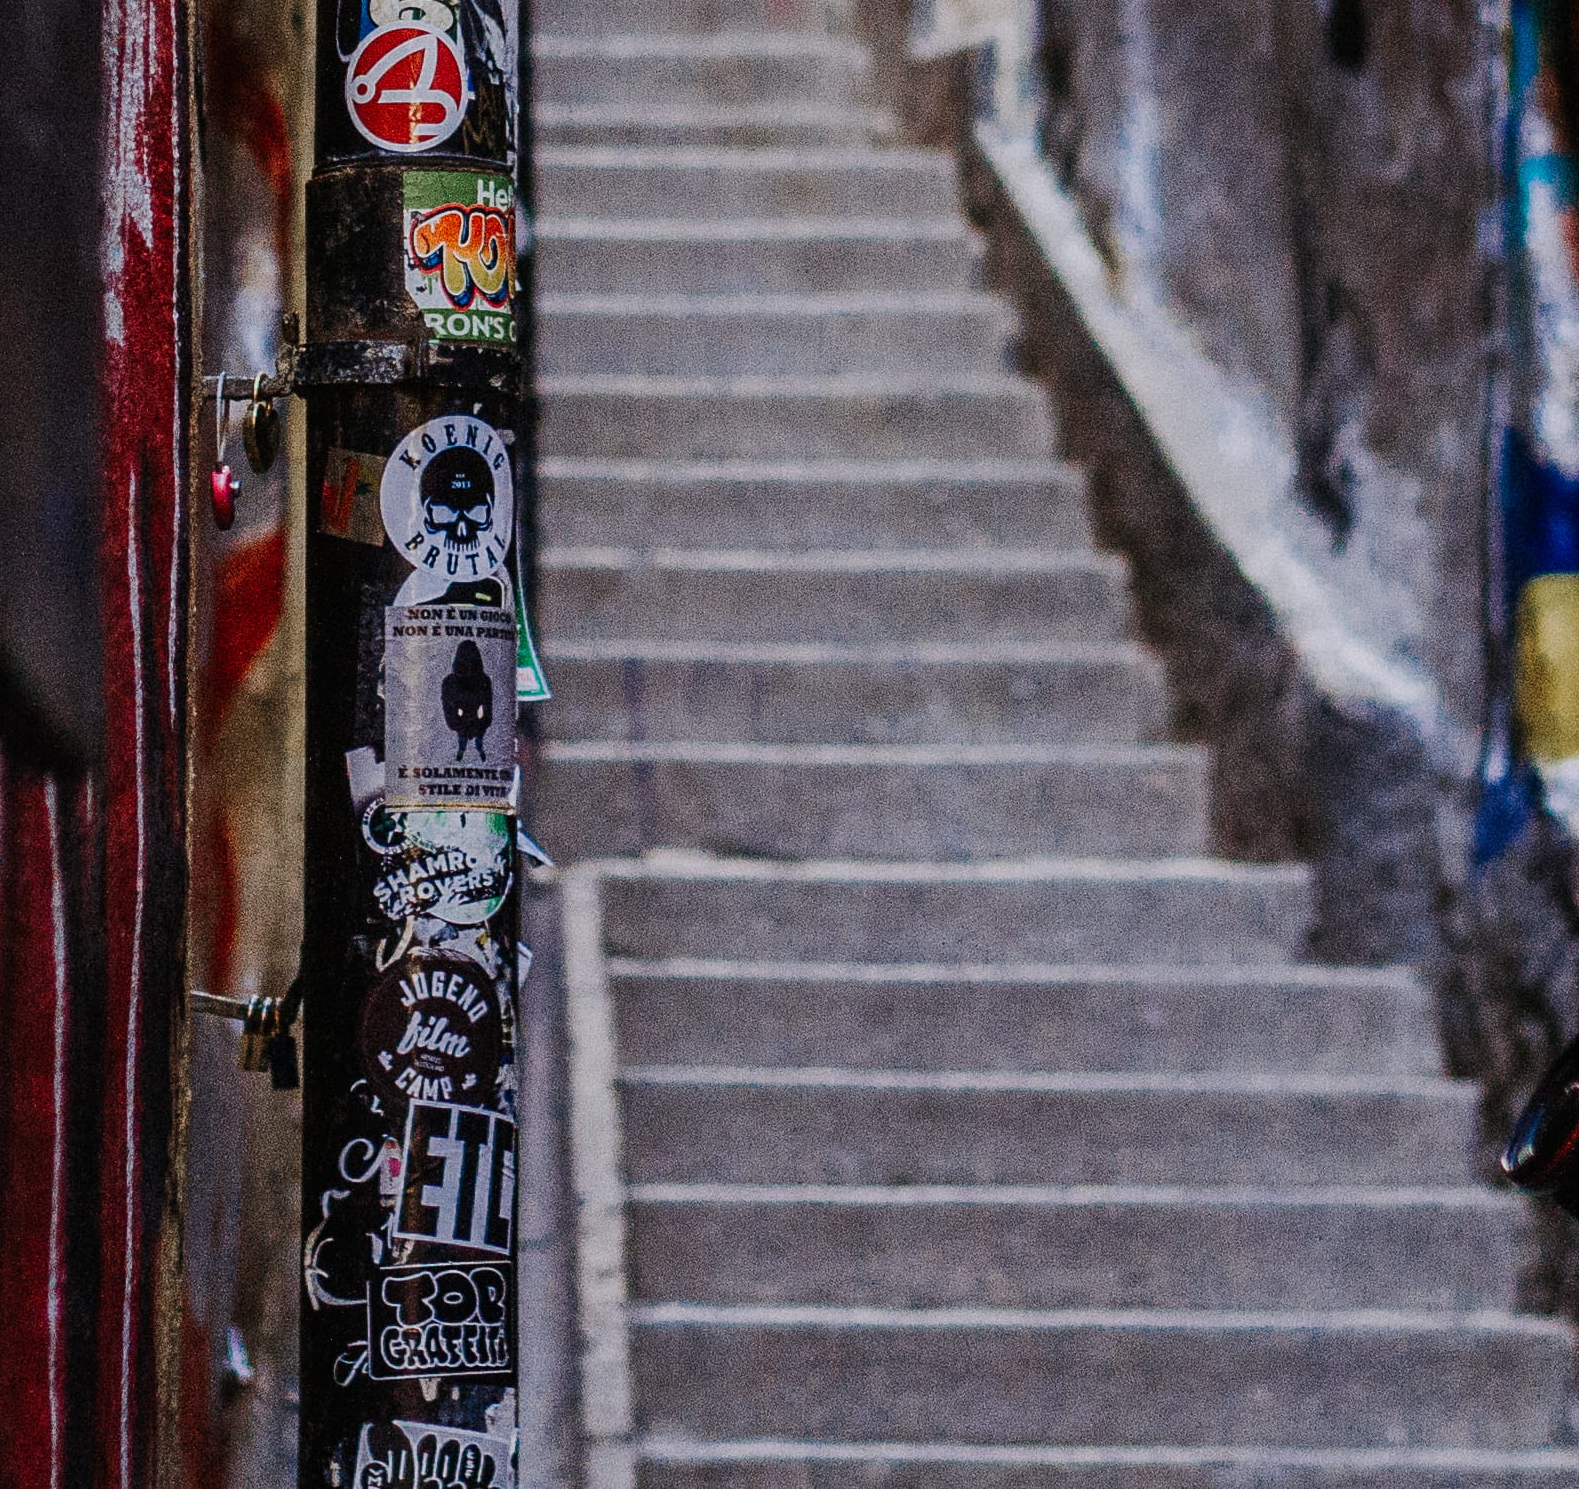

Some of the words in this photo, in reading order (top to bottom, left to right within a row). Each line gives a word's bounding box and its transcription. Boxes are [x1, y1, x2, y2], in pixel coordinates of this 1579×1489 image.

[399, 423, 506, 471] KOENIG
[405, 531, 506, 576] BRUTAL
[392, 625, 428, 637] NON
[431, 622, 442, 637] È
[444, 626, 476, 638] UNA
[407, 608, 443, 620] NON
[446, 606, 456, 620] È
[458, 609, 478, 621] UN
[398, 764, 408, 779] È
[413, 766, 499, 780] SOLAMENTE
[418, 784, 462, 796] STILE
[464, 784, 480, 796] DI
[398, 869, 494, 904] ROVERS
[398, 970, 490, 1024] JUGEND
[396, 1010, 471, 1058] film
[394, 1067, 453, 1102] CAMP
[382, 1266, 507, 1328] TOP
[380, 1322, 510, 1370] GRAFFITI
